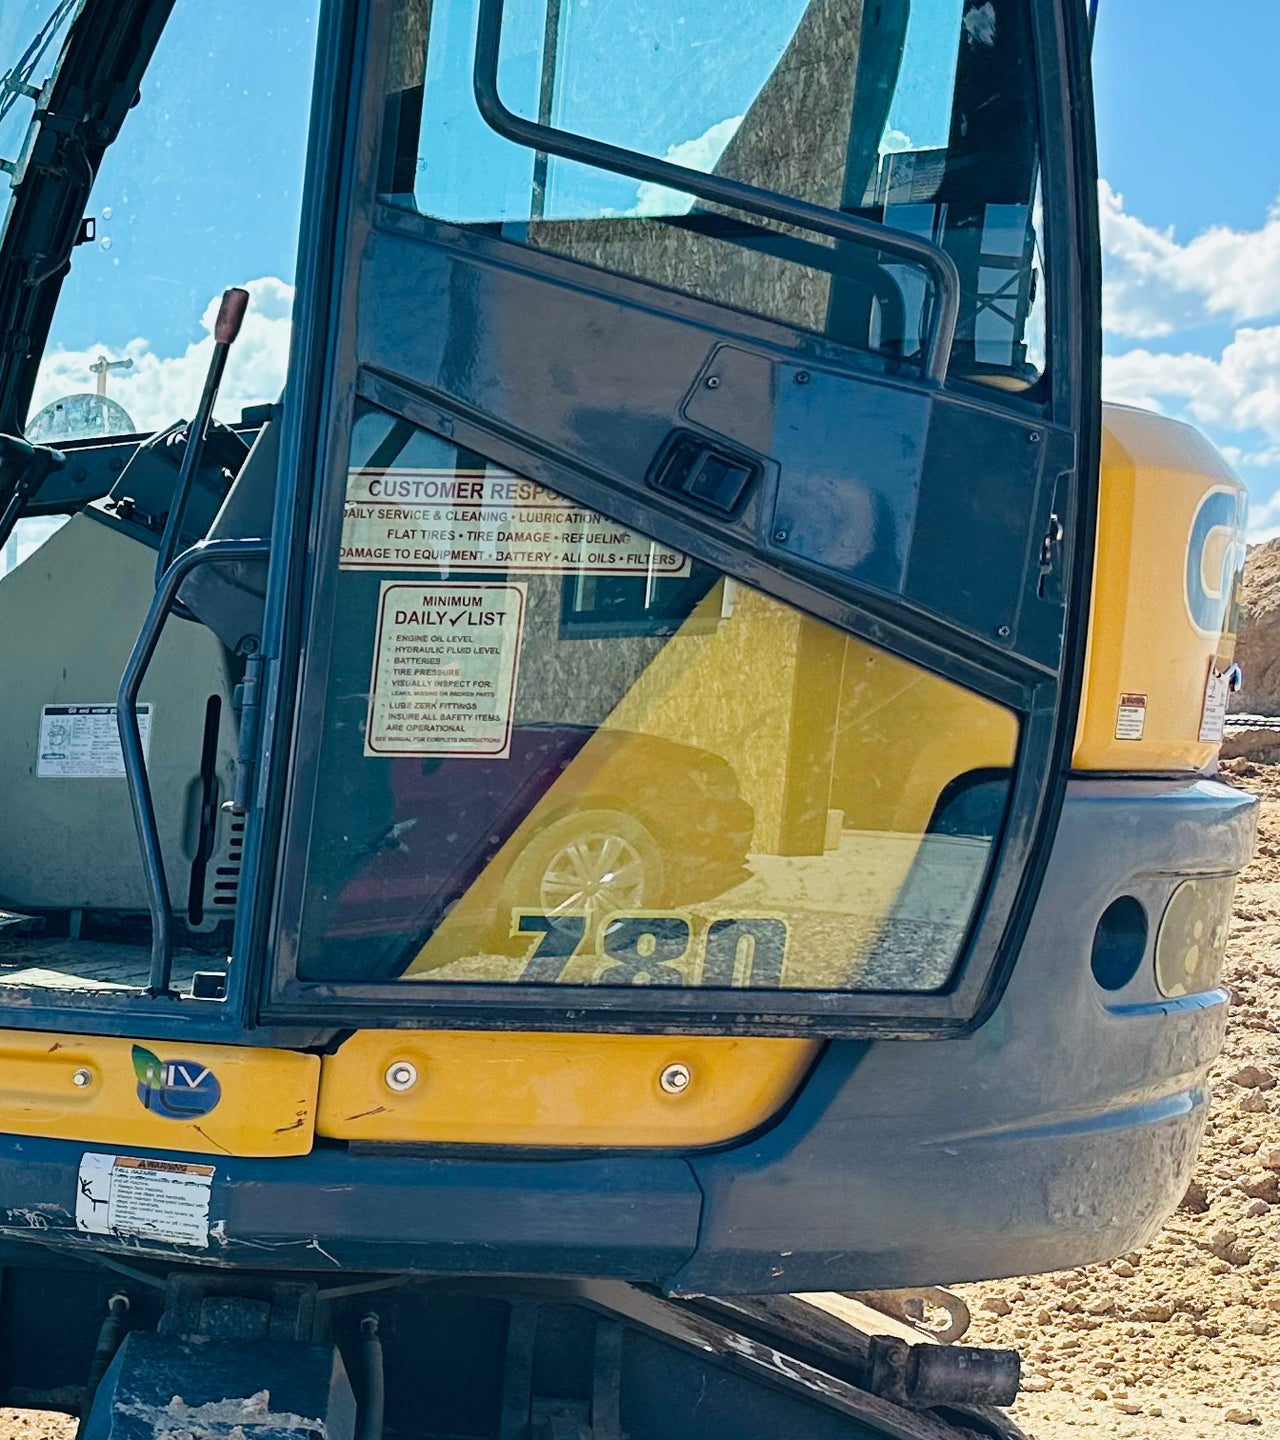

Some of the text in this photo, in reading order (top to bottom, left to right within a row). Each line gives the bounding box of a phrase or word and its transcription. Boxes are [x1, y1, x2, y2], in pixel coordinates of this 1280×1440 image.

[368, 479, 484, 500] CUSTOMER
[377, 508, 430, 520] SERVICE
[433, 509, 442, 520] &
[445, 510, 508, 522] CLEANING
[519, 512, 601, 524] LUBRICATION
[387, 529, 631, 544] FLAT TIRES TIRE DAMAGE REFUELING
[339, 547, 676, 565] DAMAGE TO EQUIPMENT BATTERY ALL OILS FILTERS
[422, 596, 482, 607] MINIMUM
[394, 610, 507, 626] DAILY LIST
[446, 635, 474, 643] LEVEL
[474, 647, 500, 655] LEVEL
[393, 657, 441, 665] BATTERIES
[421, 713, 438, 721] ALL
[405, 724, 466, 732] OPERATIONAL
